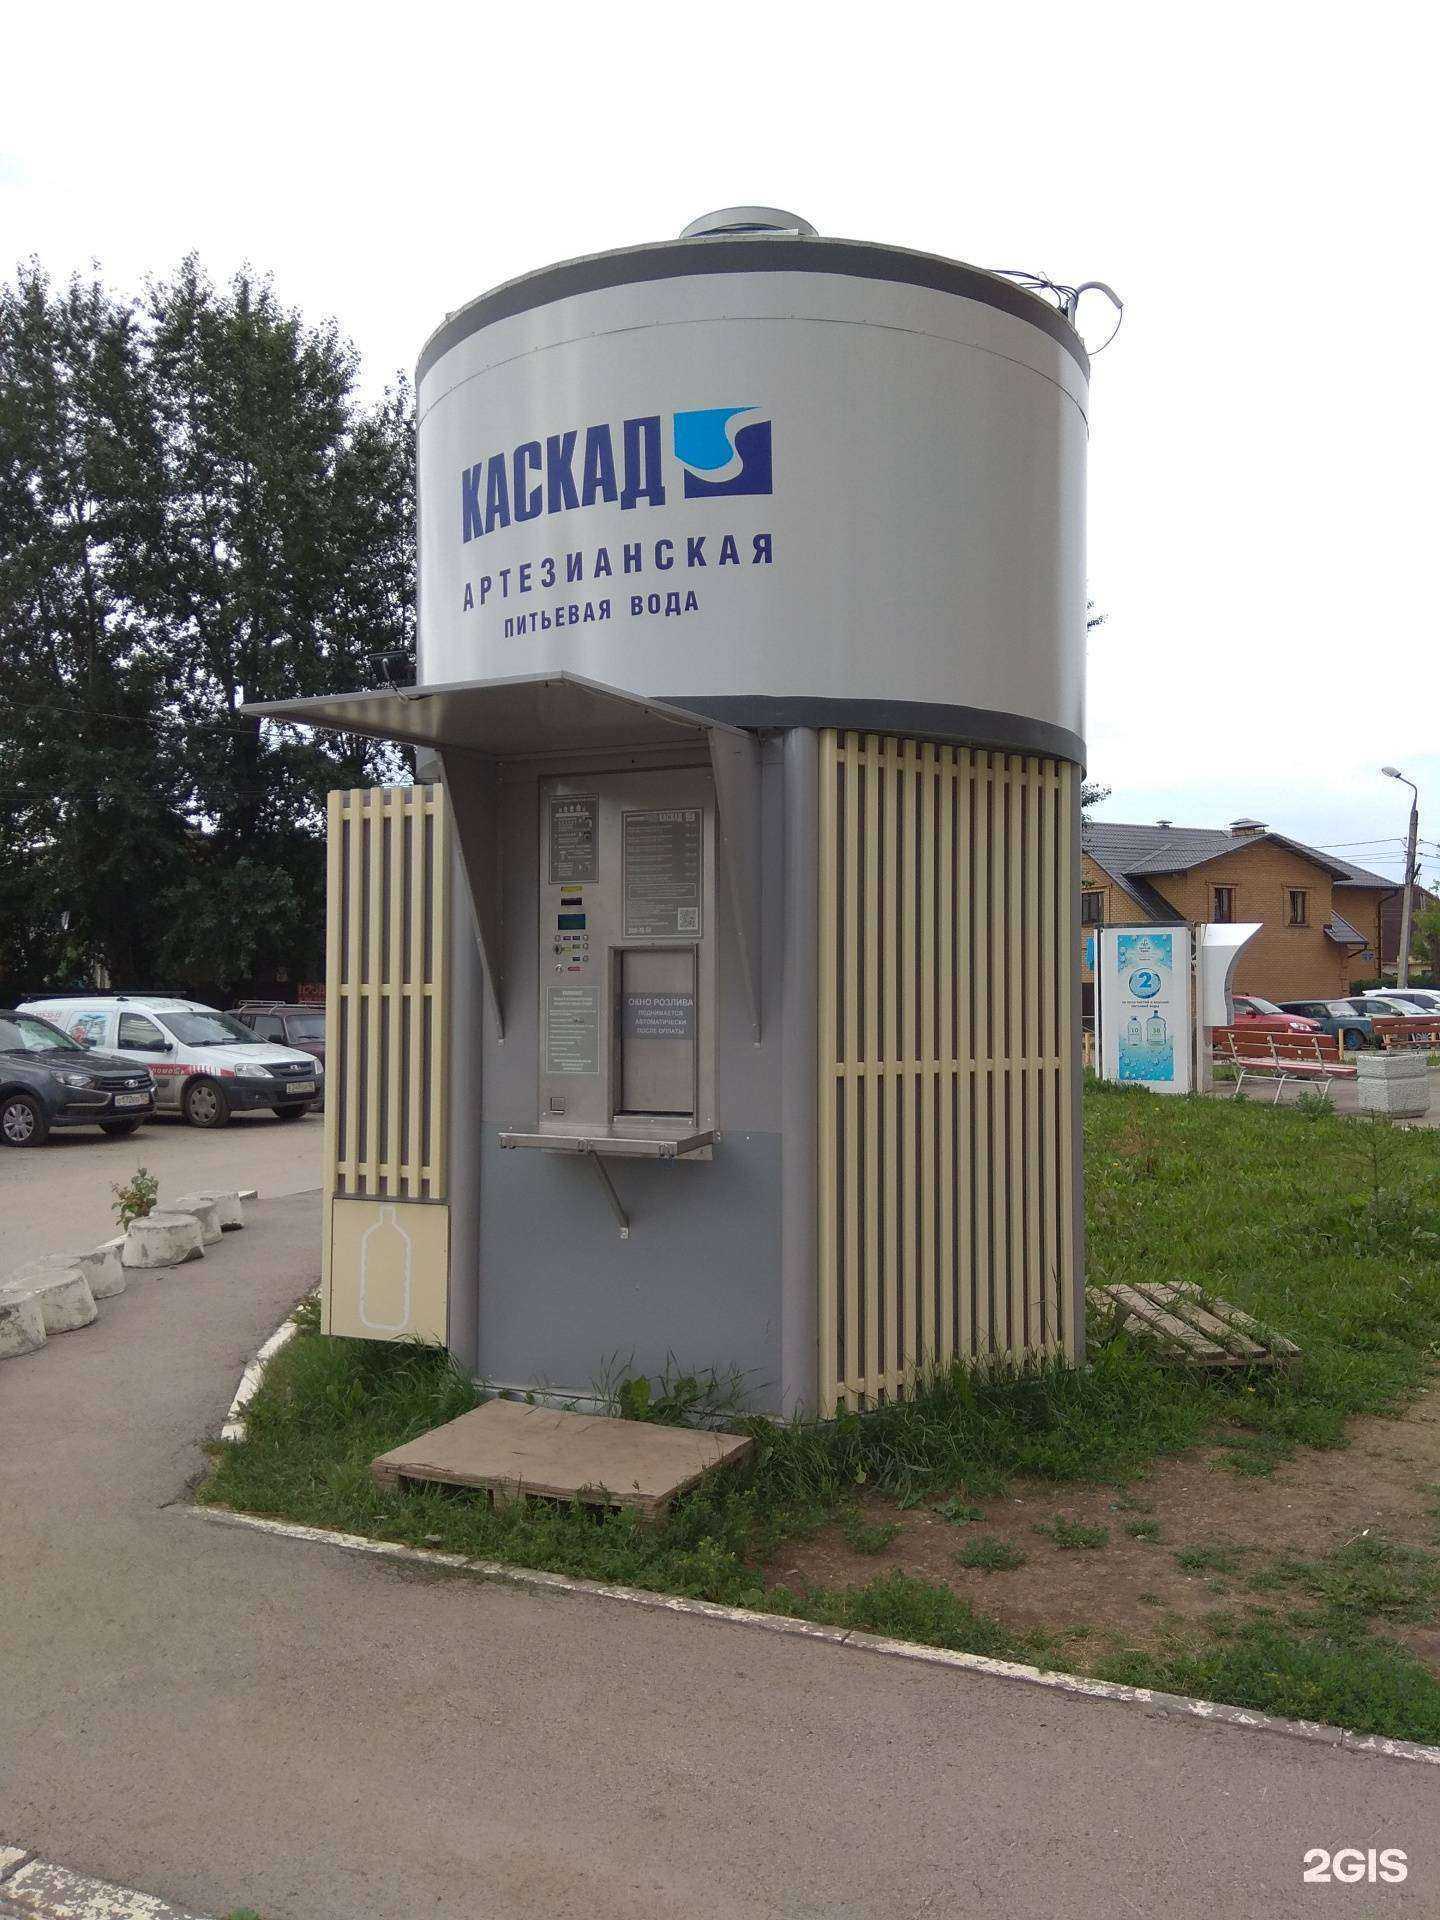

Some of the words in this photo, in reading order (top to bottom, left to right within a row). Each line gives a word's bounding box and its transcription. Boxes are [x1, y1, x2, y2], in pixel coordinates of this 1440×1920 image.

[462, 415, 666, 544] КАСКАД
[462, 533, 774, 612] АРТЕЗИАНСКАЯ
[503, 598, 612, 638] ПИТЬЕВАЯ
[630, 590, 699, 617] ВОДА
[628, 998, 652, 1007] ОКНО
[653, 998, 694, 1007] РОЗЛИВА
[1137, 971, 1152, 989] 2
